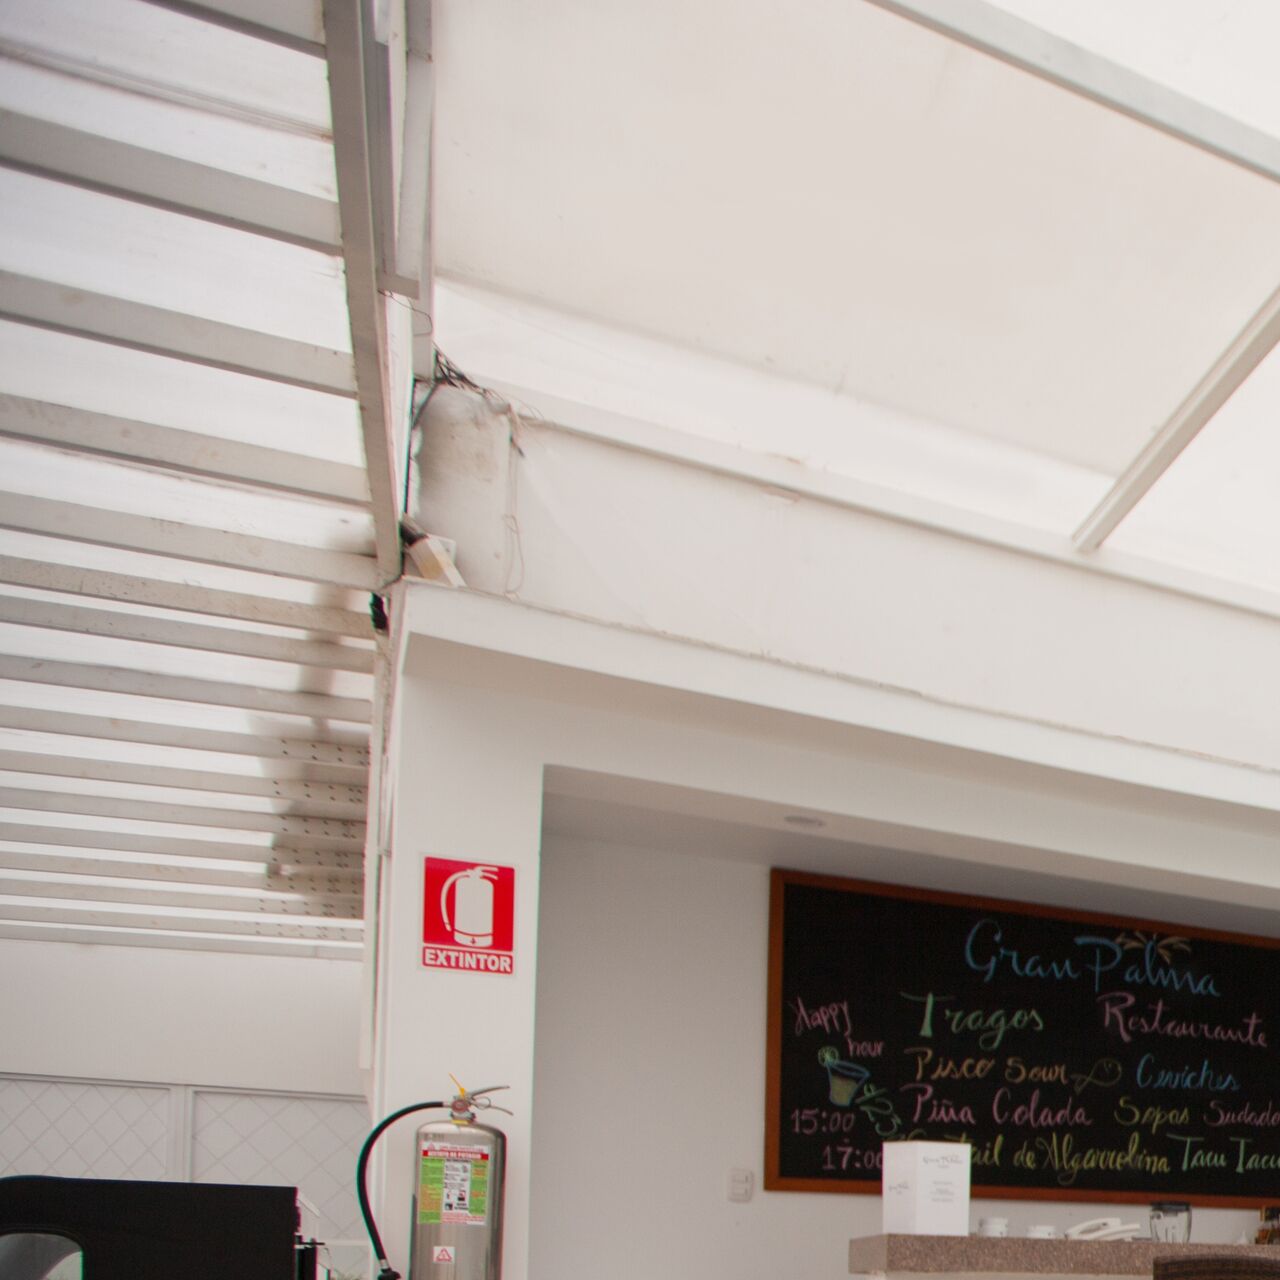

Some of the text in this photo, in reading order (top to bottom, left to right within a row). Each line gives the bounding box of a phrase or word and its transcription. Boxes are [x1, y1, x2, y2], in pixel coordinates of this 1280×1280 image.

[424, 948, 512, 973] EXTINTOR
[964, 918, 1222, 999] Gran Palma
[900, 991, 1045, 1050] Tragos
[1097, 990, 1268, 1049] Restaurante
[903, 1046, 996, 1082] Pisco
[790, 1107, 857, 1136] 15:00
[991, 1086, 1093, 1129] Colada
[1012, 1139, 1038, 1171] de
